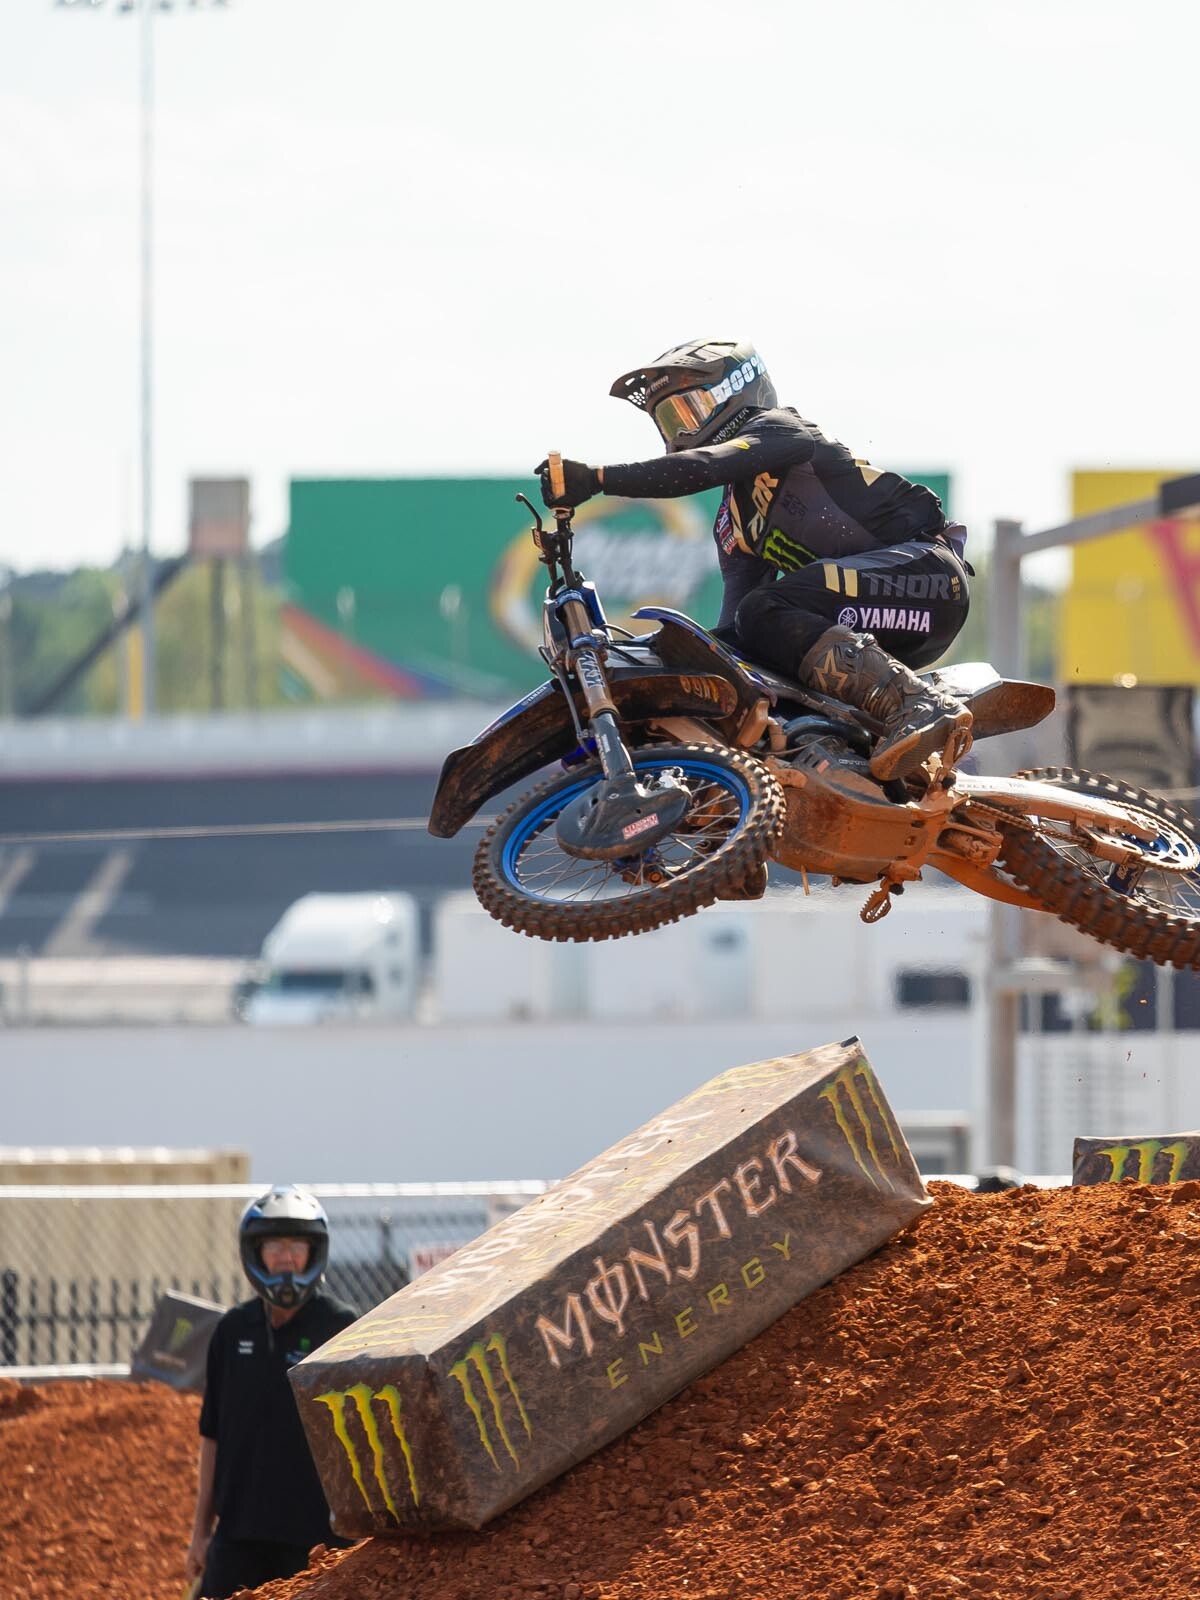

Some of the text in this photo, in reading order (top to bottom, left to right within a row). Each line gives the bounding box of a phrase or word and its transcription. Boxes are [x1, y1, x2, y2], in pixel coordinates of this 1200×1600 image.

[861, 572, 950, 600] THOR
[860, 607, 930, 632] YAMAHA
[607, 1232, 793, 1389] ENERGY
